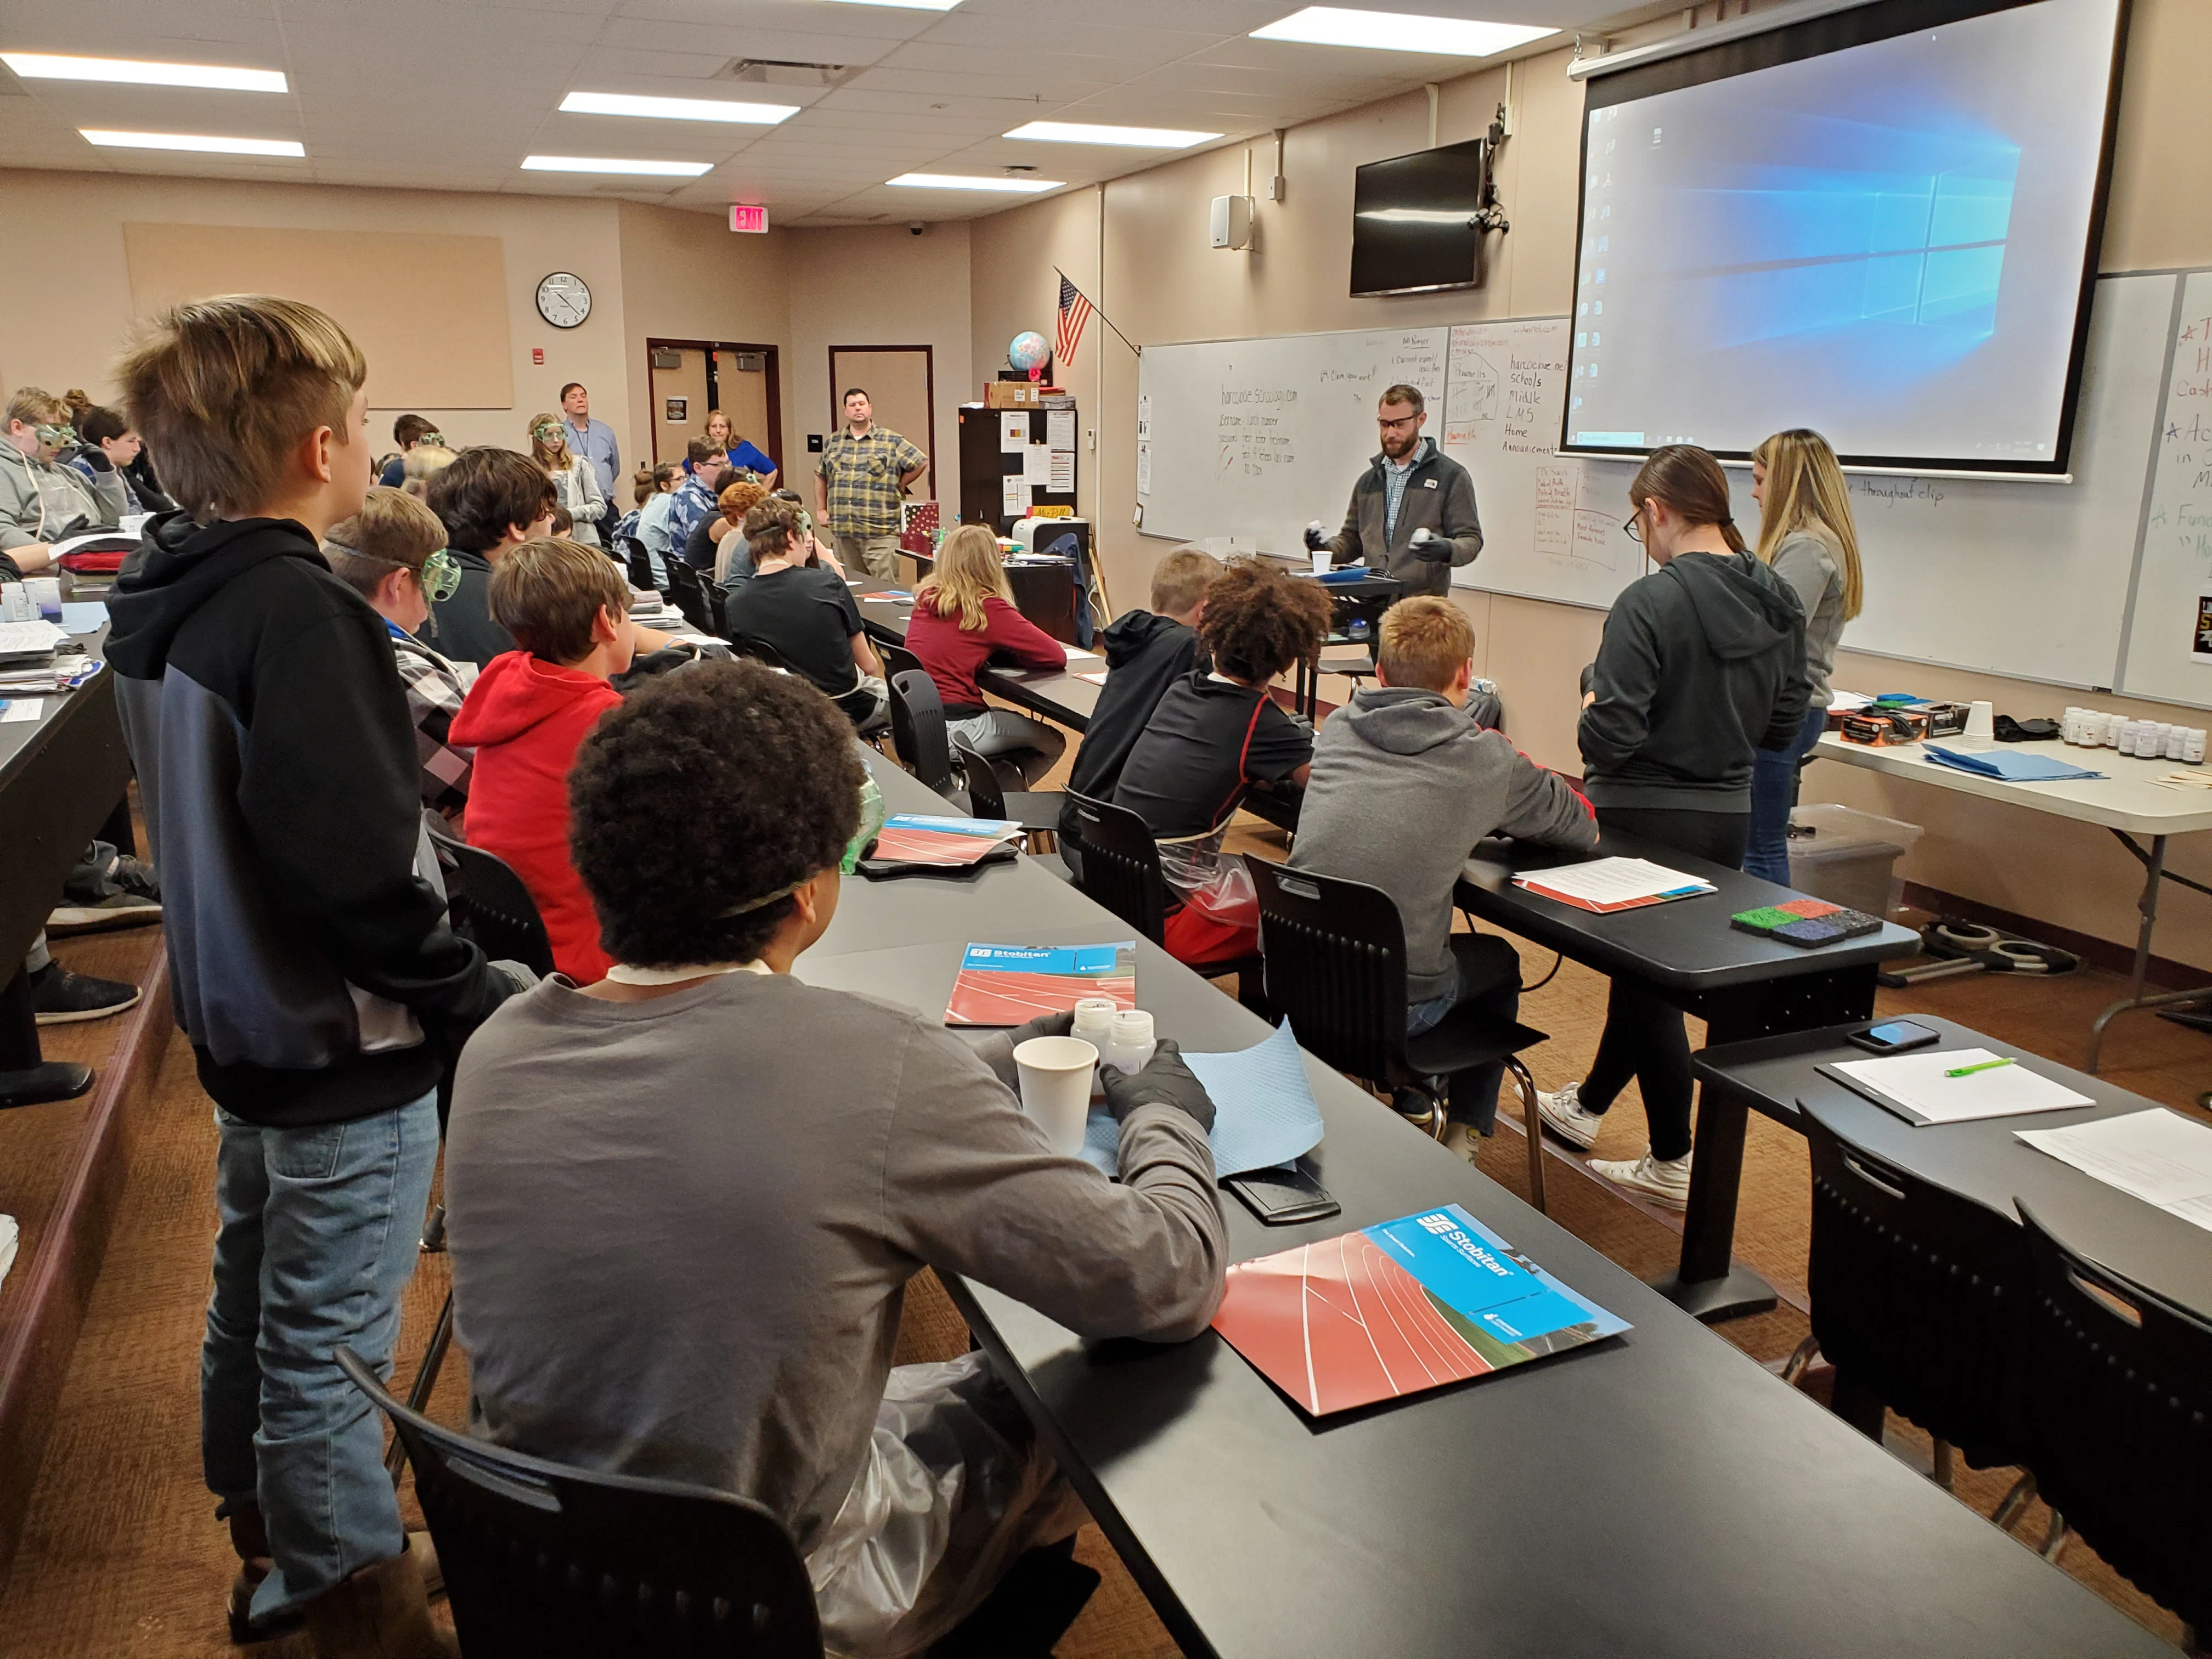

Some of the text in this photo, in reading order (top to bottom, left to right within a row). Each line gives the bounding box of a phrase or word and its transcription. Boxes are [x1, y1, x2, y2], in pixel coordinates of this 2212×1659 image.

[736, 207, 763, 230] EXIT
[1510, 372, 1542, 387] schools
[1506, 406, 1533, 422] LMS
[1505, 423, 1527, 438] Home
[2177, 454, 2191, 464] in
[1860, 478, 1944, 508] throughout clip
[1448, 1231, 1509, 1277] Stobitan
